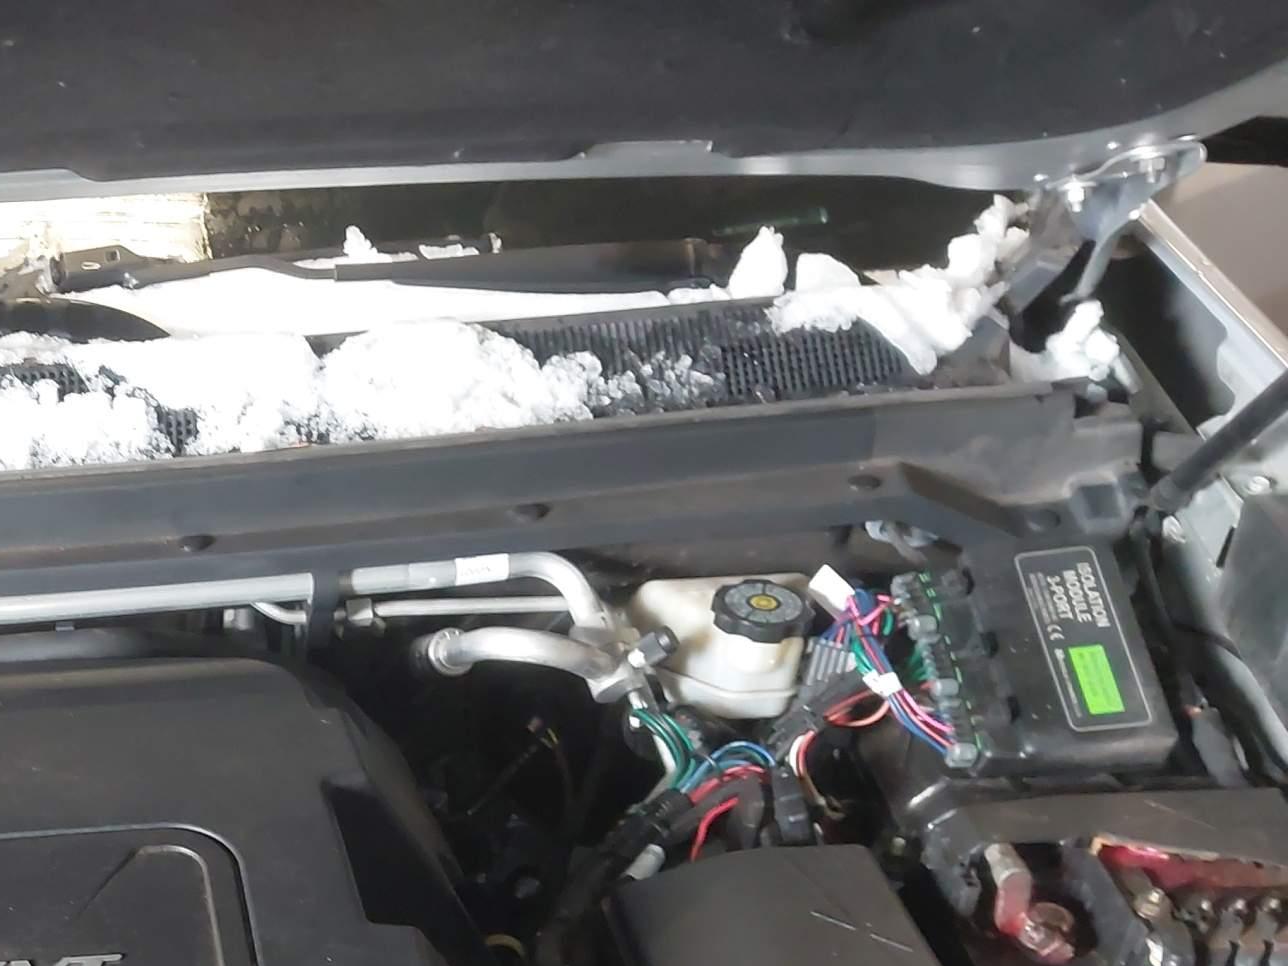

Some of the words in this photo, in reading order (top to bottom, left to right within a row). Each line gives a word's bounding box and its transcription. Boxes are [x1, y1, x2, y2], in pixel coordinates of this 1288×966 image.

[1046, 575, 1074, 620] 3-PORT
[1062, 570, 1092, 623] MODULE
[1077, 562, 1111, 627] ISOLATION
